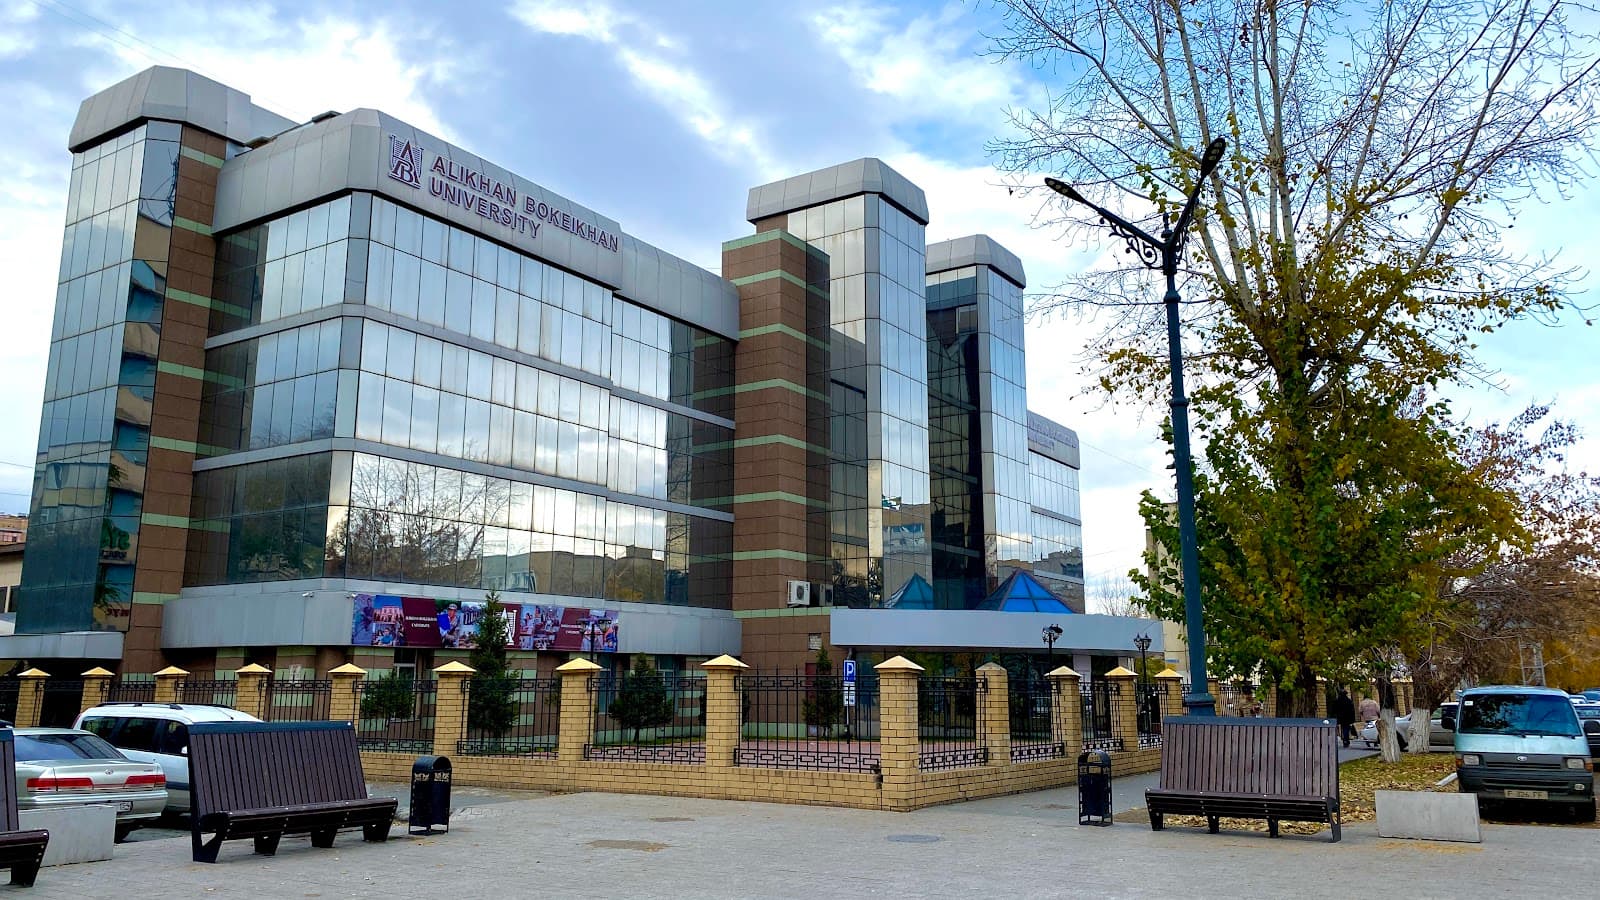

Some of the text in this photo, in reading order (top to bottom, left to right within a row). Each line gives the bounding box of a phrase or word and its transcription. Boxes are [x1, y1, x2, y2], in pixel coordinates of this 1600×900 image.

[429, 176, 541, 238] UNIVERSITY
[430, 155, 619, 253] ALIKHAN BOKEIKHAN
[846, 662, 854, 681] P
